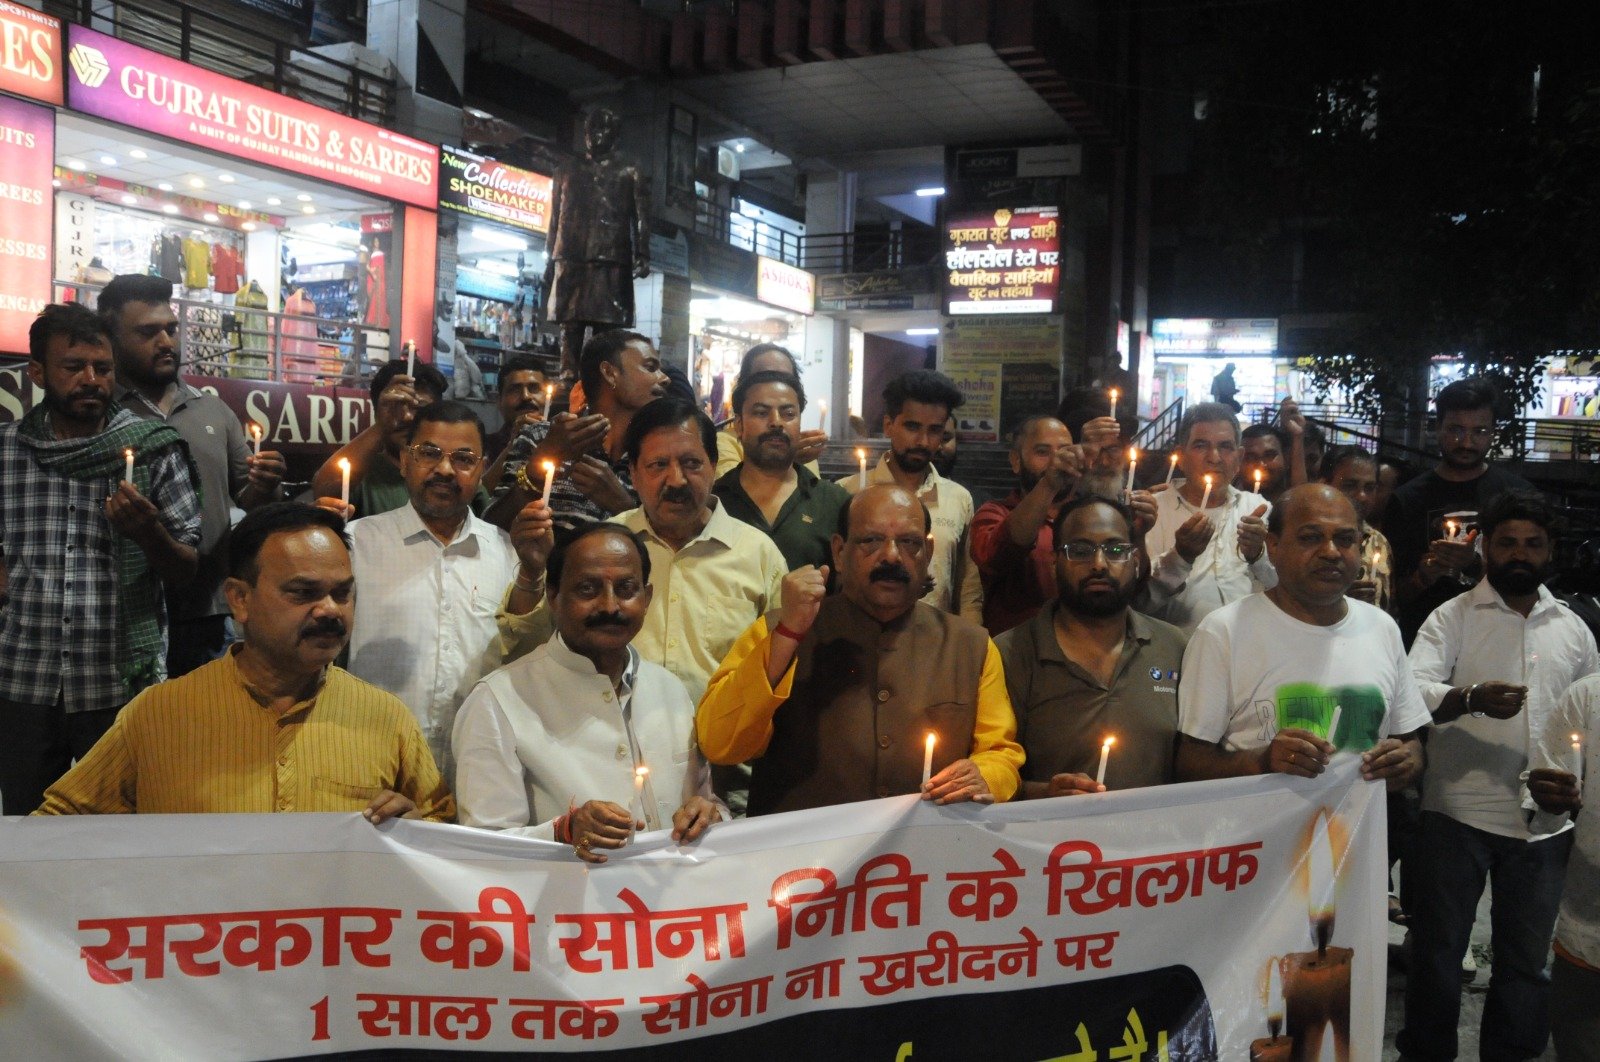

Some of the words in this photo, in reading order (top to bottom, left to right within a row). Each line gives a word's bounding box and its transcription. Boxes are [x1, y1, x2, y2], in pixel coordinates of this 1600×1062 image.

[0, 19, 54, 82] ES
[120, 65, 242, 129] GUJRAT
[246, 103, 321, 152] SUITS
[325, 130, 345, 159] &
[349, 135, 432, 186] SAREES
[188, 121, 198, 133] A
[199, 124, 226, 141] UNIT
[226, 132, 242, 145] OF
[242, 136, 281, 156] GUJRAT
[281, 147, 336, 171] HANDLOOM
[335, 162, 382, 185] EMPORIUM
[441, 151, 467, 170] New
[463, 161, 549, 203] Collection
[449, 177, 545, 215] SHOEMAKER
[946, 244, 1014, 269] हॉलसेल
[1039, 251, 1059, 266] पर
[950, 227, 988, 246] गुजरात
[990, 226, 1009, 245] सूट
[1031, 220, 1057, 242] साड़ी
[761, 266, 812, 294] ASHOKA
[949, 269, 1001, 286] वैवाहिक
[246, 386, 376, 447] SARE
[78, 907, 402, 985] सरकार
[417, 886, 536, 973] की
[554, 887, 749, 974] सोना
[767, 853, 929, 950] निति
[945, 847, 1026, 923] के
[1043, 840, 1264, 916] खिलाफ
[310, 995, 331, 1042] 1
[356, 993, 499, 1041] साल
[508, 997, 625, 1041] तक
[639, 973, 773, 1034] सोना
[785, 957, 846, 1001] ना
[857, 926, 1043, 996] खरीदने
[1054, 931, 1121, 970] पर
